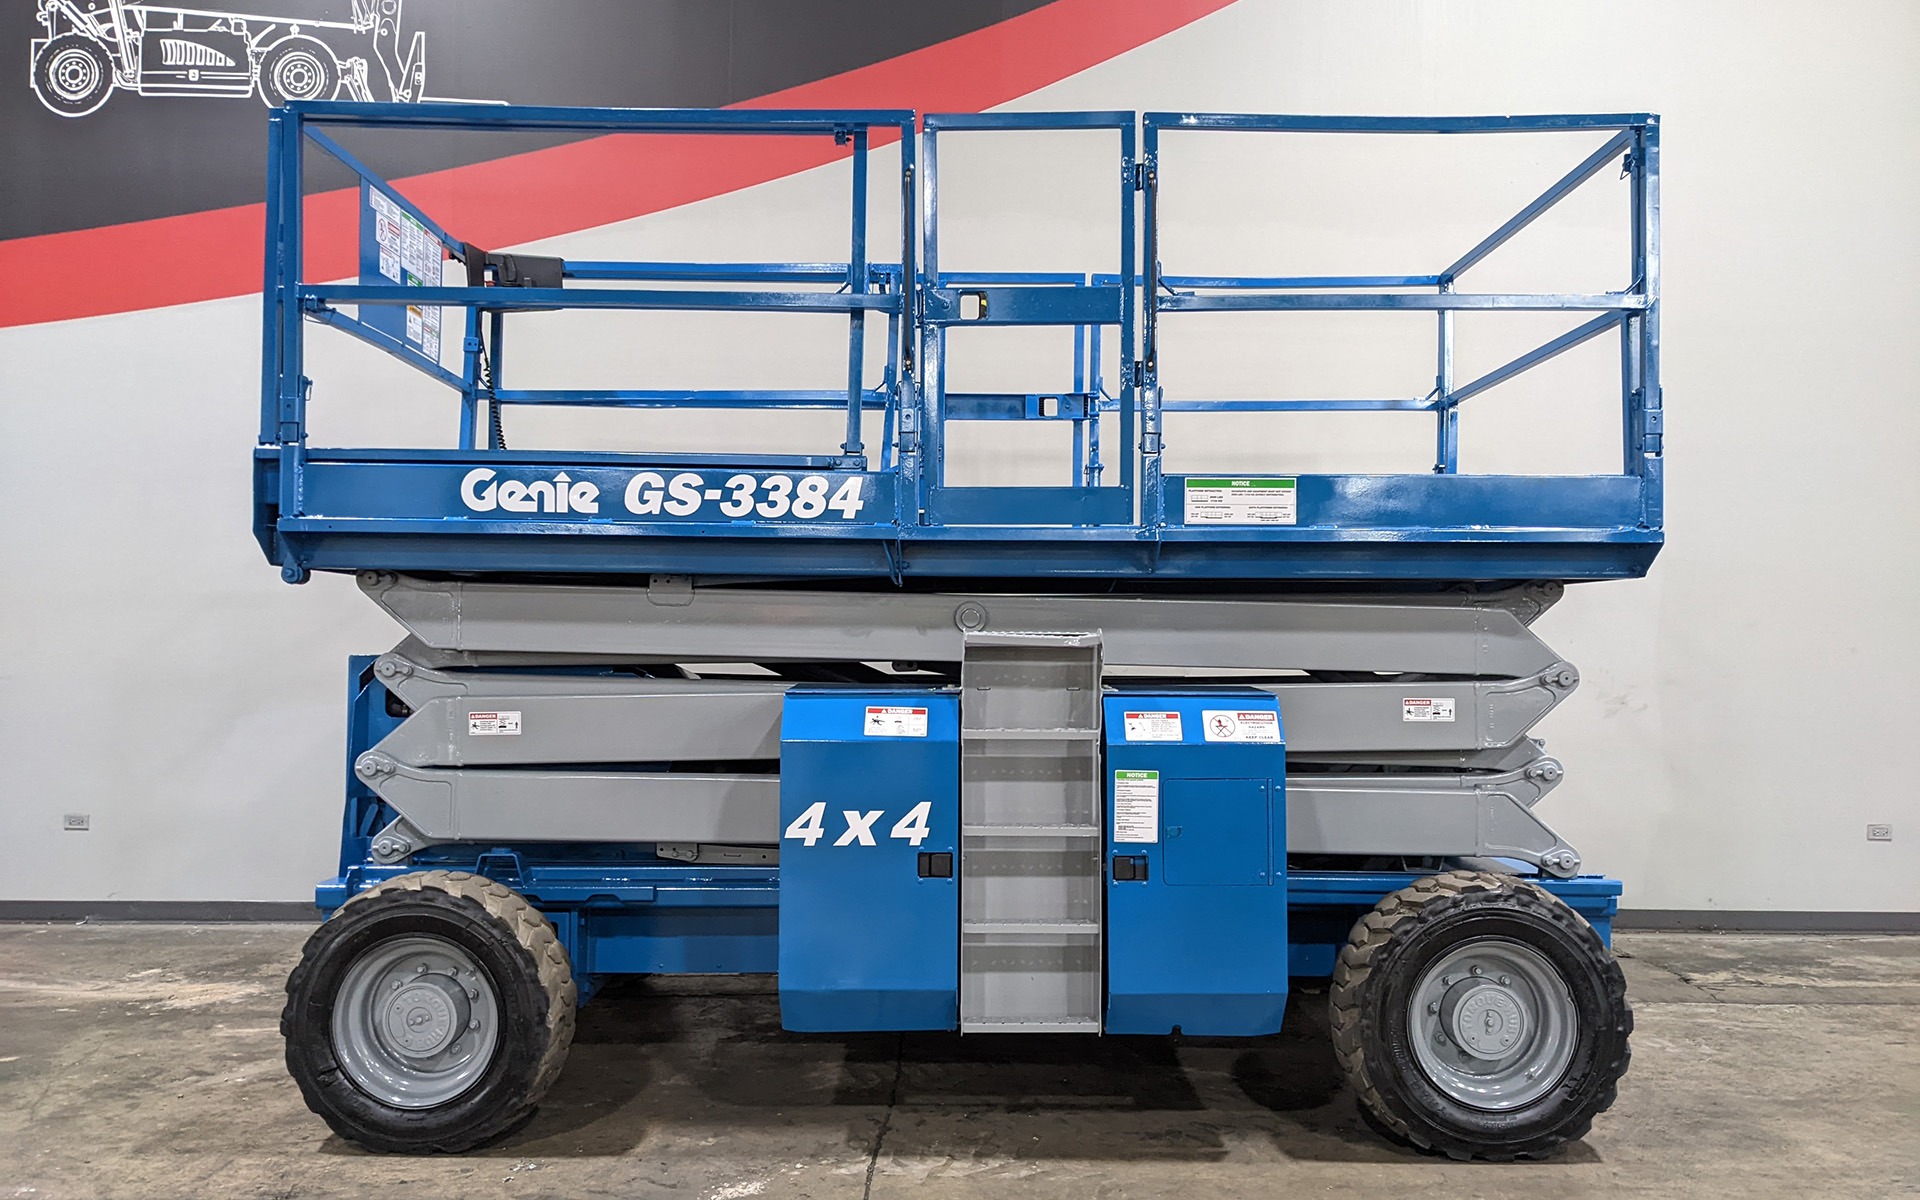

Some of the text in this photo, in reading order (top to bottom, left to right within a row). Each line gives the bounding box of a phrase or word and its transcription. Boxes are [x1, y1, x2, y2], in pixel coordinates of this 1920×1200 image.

[460, 467, 865, 520] Genie GS-3384
[784, 801, 827, 847] 4
[889, 801, 932, 846] 4
